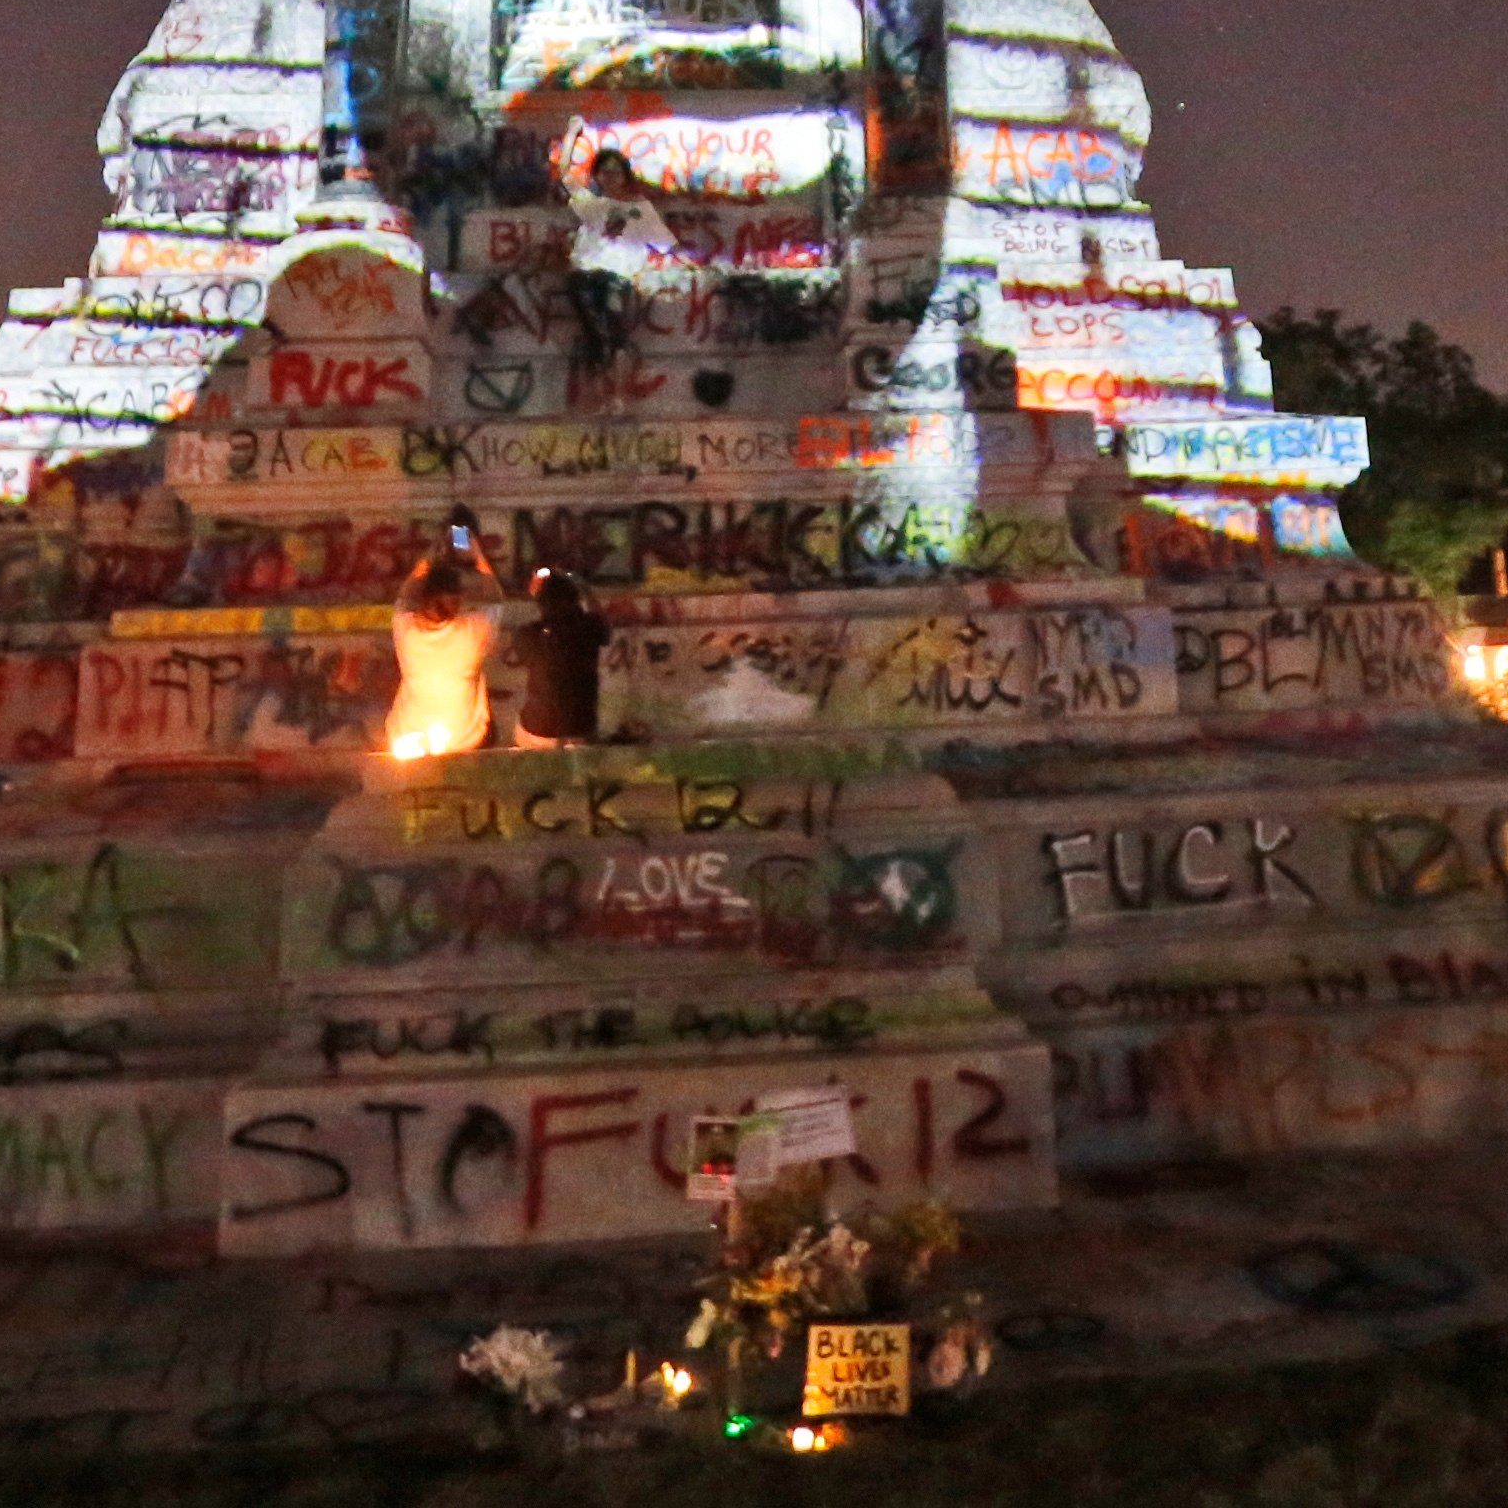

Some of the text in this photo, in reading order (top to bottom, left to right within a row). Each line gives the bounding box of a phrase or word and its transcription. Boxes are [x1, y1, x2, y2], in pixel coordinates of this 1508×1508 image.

[679, 126, 776, 168] YOUR
[982, 118, 1117, 186] ACAB
[402, 780, 647, 846] FUCK
[596, 851, 749, 908] LOVE
[1048, 818, 1322, 924] FUCK
[524, 1086, 880, 1230] FUK
[912, 1068, 1030, 1184] 12
[816, 1330, 900, 1359] BLACK
[831, 1359, 891, 1383] LIVES
